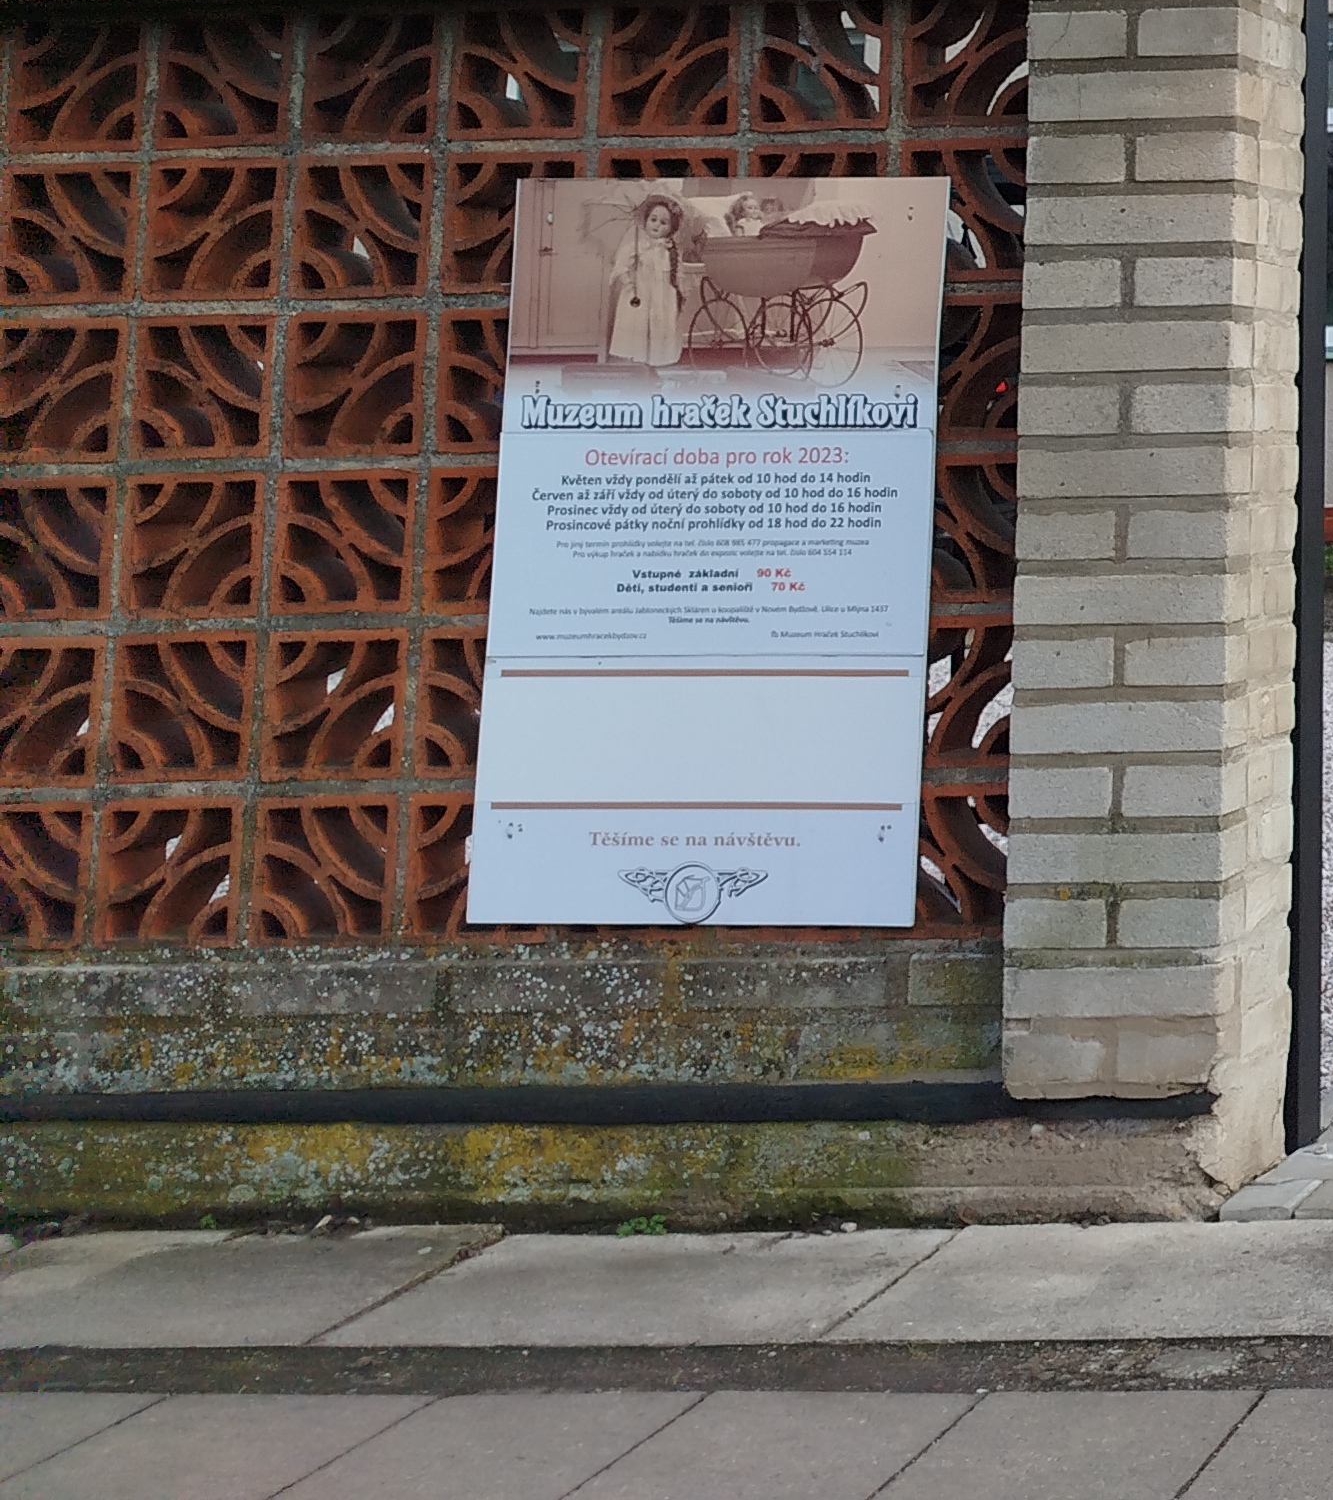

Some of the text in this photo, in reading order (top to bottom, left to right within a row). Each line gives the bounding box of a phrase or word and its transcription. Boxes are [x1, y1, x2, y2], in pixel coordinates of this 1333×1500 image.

[521, 393, 918, 429] Muzeum hraček Stuchlíkovi
[585, 447, 849, 468] Otevírací doba pro rok 2023:
[561, 471, 871, 488] Květen vždy pondělí až pátek od 10 hod do 14 hodin
[532, 486, 898, 502] Červen až září vždy od úterý do soboty od 10 hod do 16 hodin
[547, 501, 882, 517] Prosinec vždy od úterý do soboty od 10 hod do 16 hodin
[546, 516, 882, 532] Prosincové pátky noční prohlídky od 18 hod do 22 hodin
[632, 568, 792, 580] Vstupné základní 90 Kč
[616, 583, 644, 594] Děti,
[648, 583, 698, 592] studenti
[712, 582, 752, 591] senioři
[771, 582, 785, 591] 70
[789, 582, 805, 591] Kč
[588, 832, 801, 847] Těšíme se na návštěvu.
